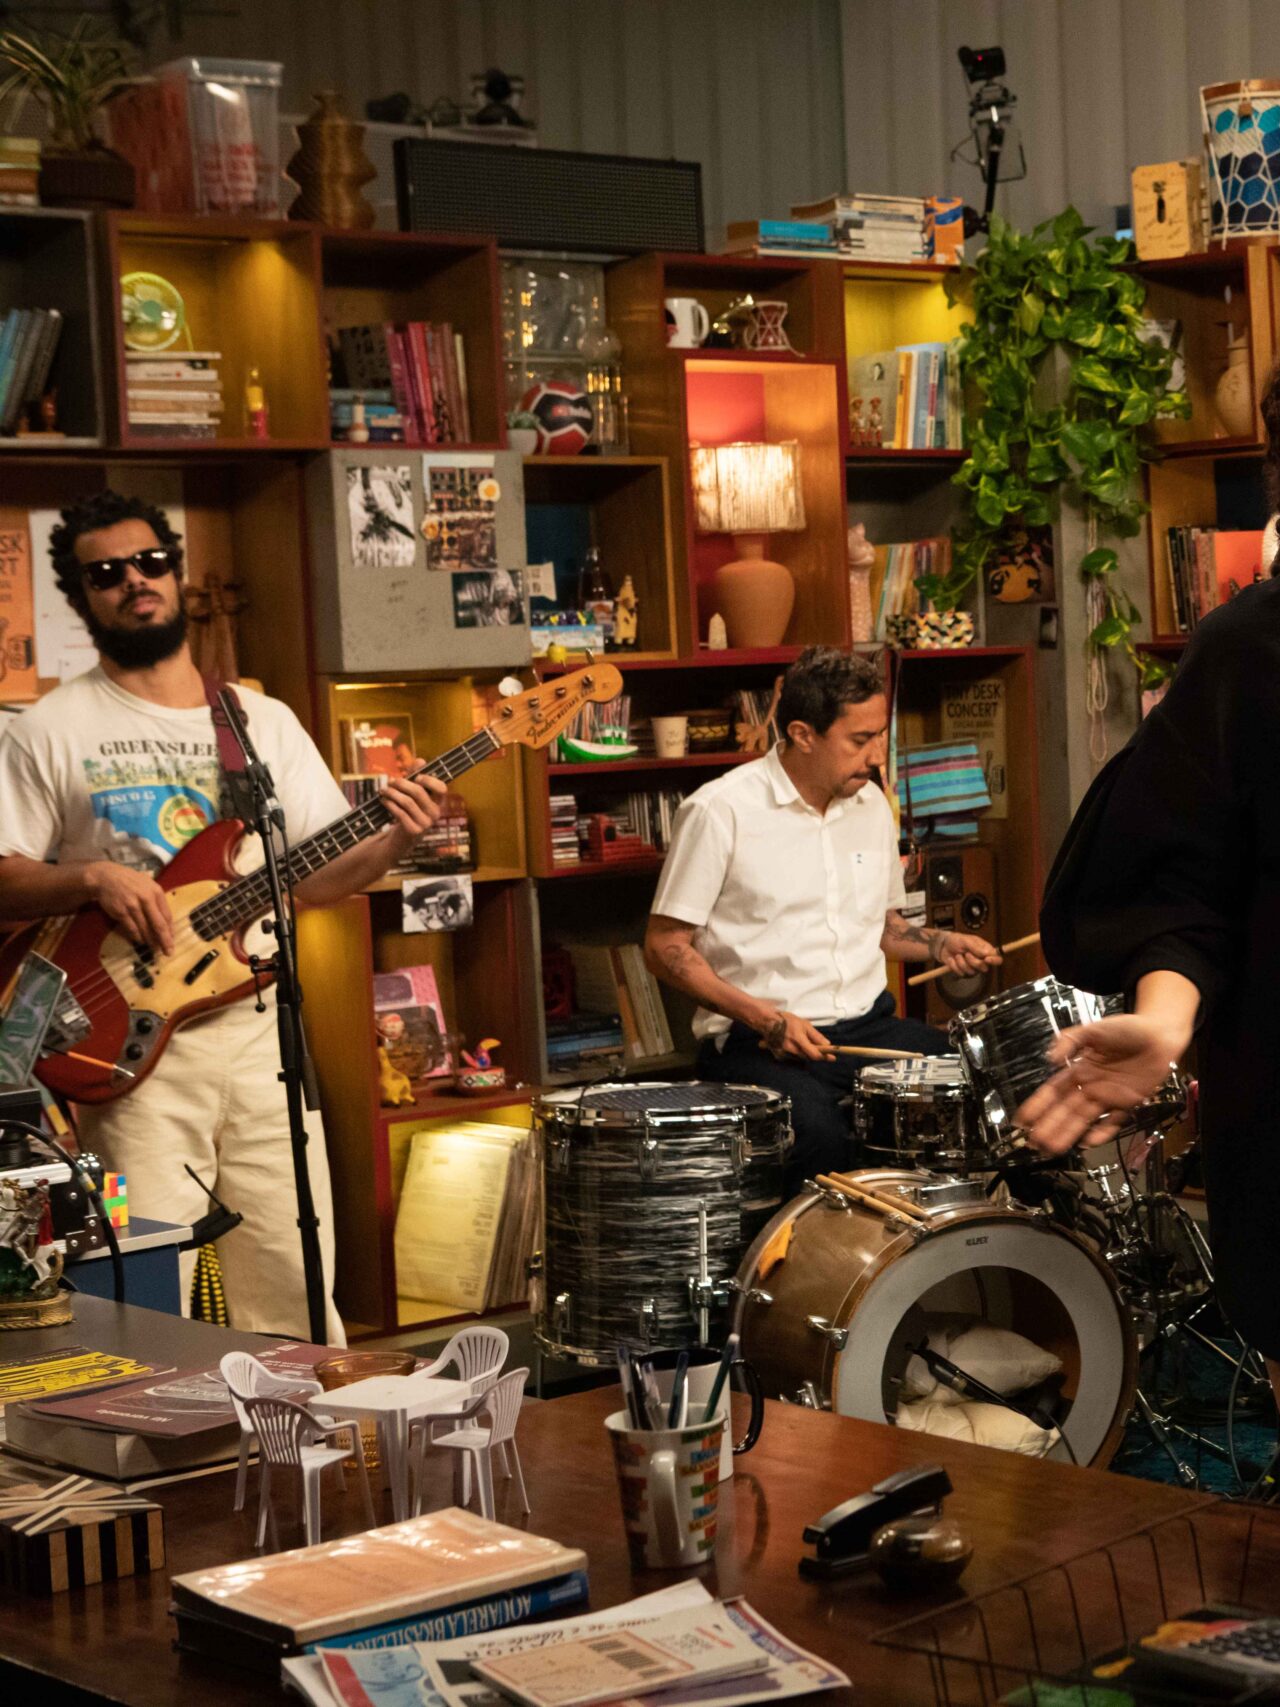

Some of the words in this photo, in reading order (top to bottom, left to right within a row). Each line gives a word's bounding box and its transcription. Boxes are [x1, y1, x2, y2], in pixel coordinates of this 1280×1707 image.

[973, 683, 1001, 699] DESK
[947, 702, 998, 718] CONCERT
[449, 1592, 532, 1642] AQUARELA
